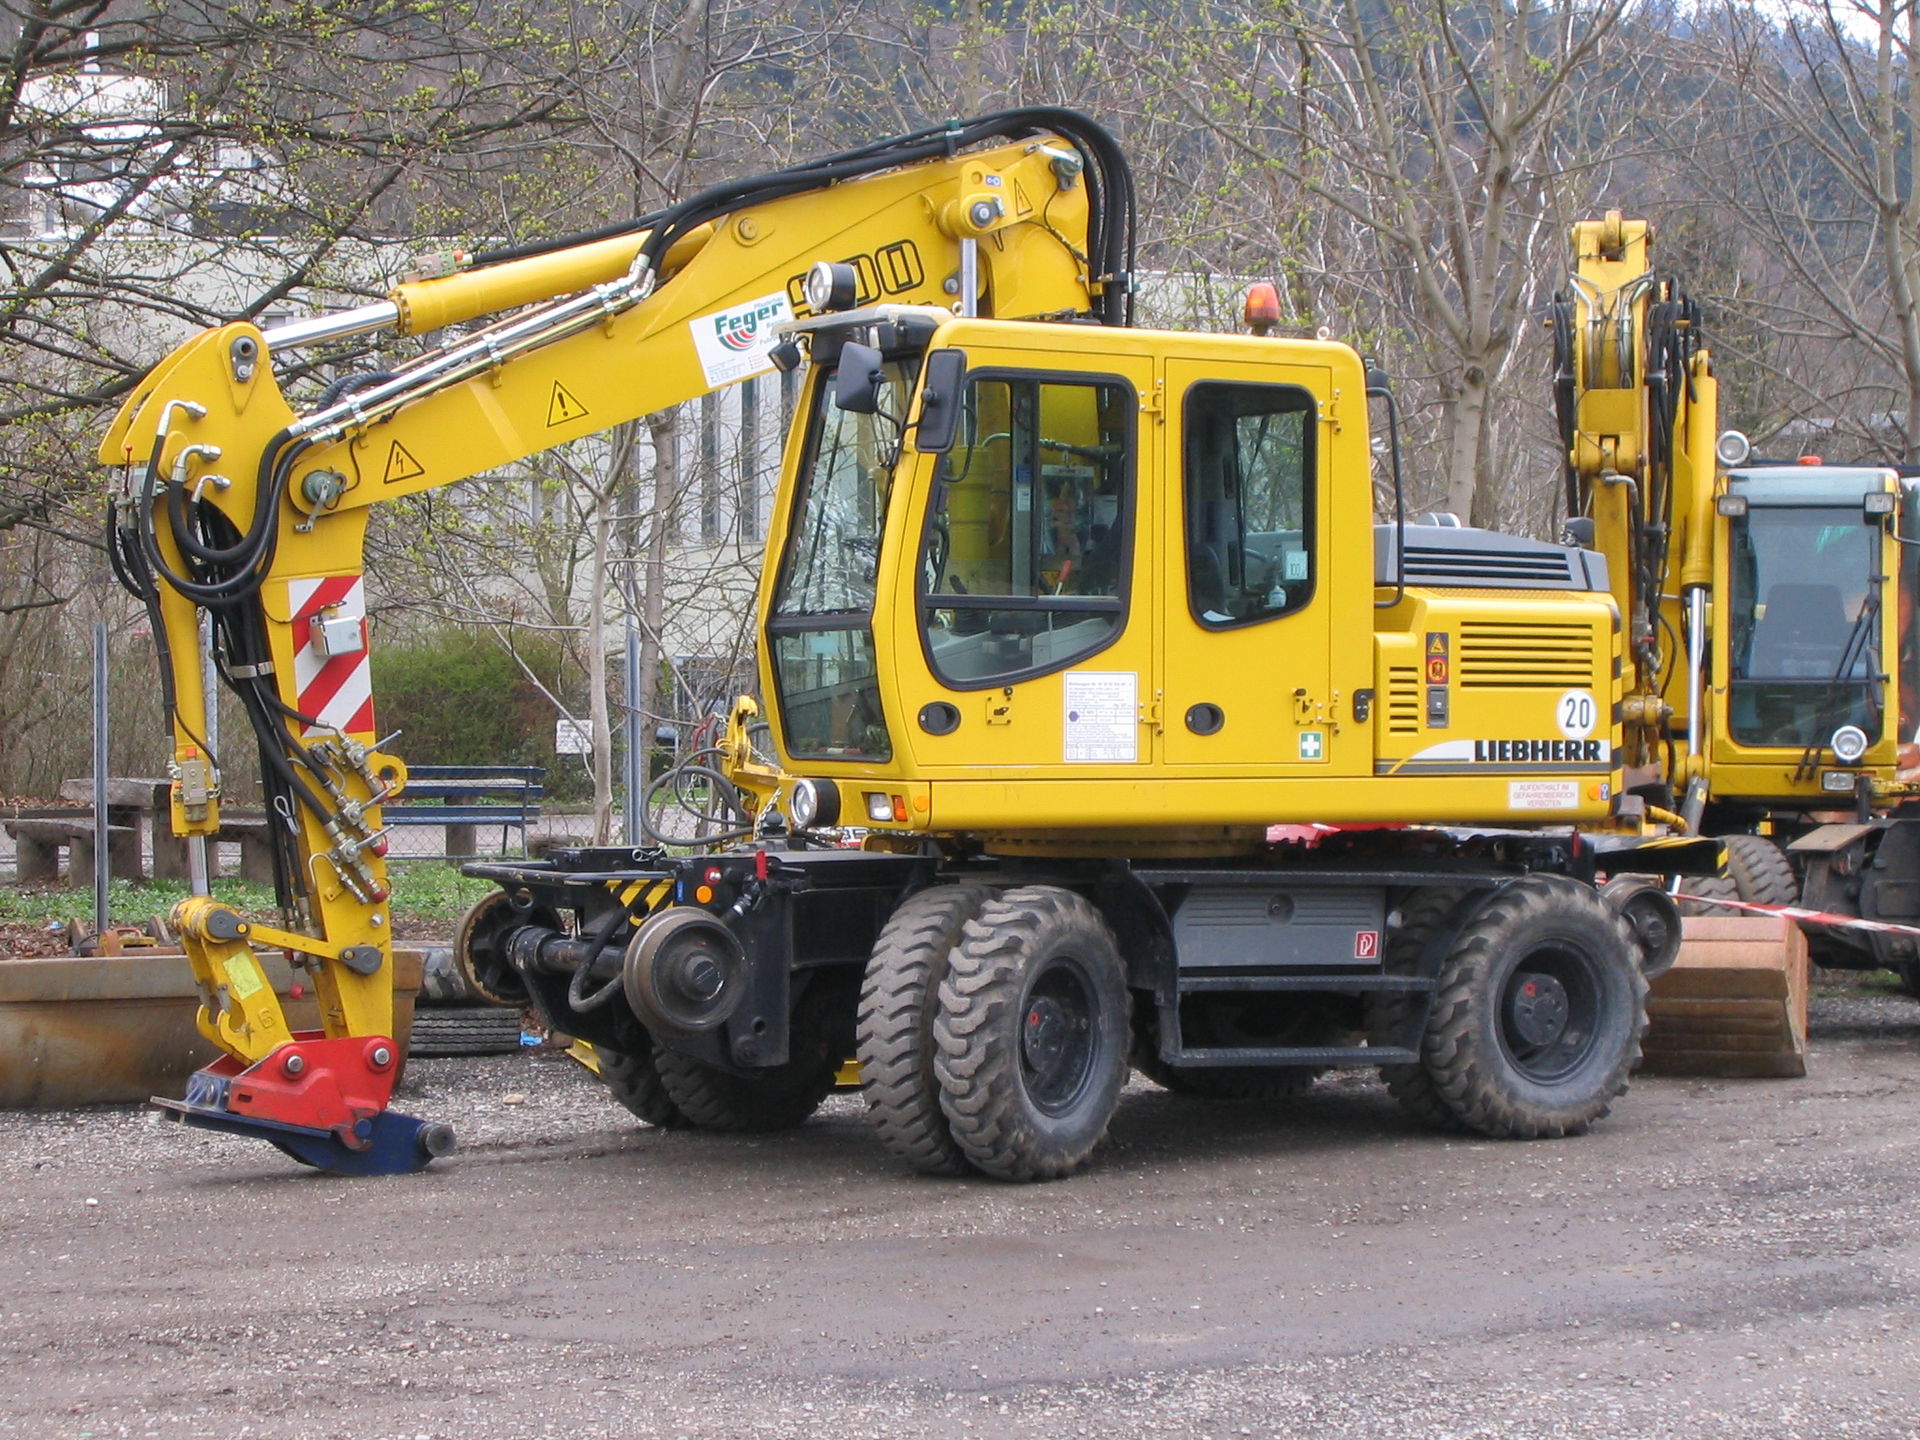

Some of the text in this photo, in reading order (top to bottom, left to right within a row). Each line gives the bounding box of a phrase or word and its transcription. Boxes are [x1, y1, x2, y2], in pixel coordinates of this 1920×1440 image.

[714, 301, 784, 335] Feger
[1565, 697, 1590, 729] 20
[1474, 739, 1601, 762] LIEBHERR
